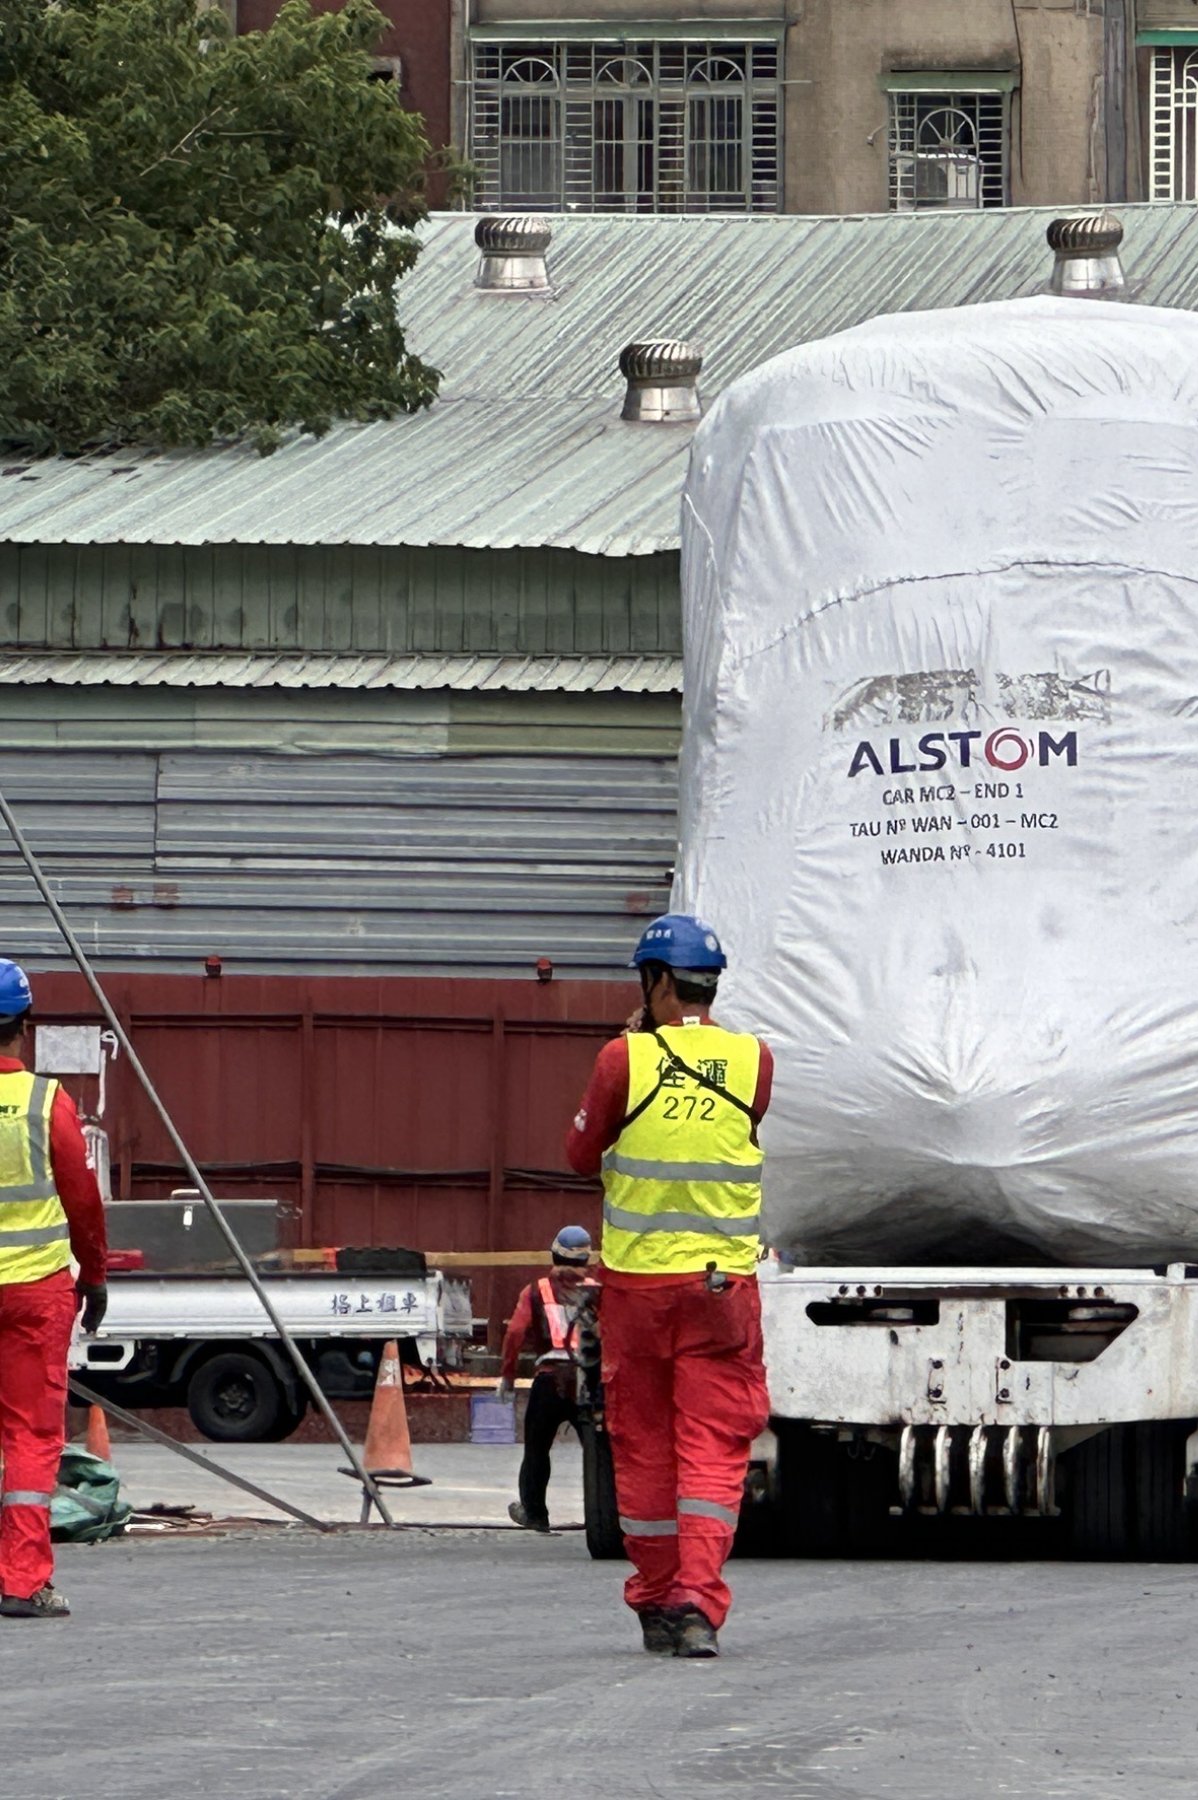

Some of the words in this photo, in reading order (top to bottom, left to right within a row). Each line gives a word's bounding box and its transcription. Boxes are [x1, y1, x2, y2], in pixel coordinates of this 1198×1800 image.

[847, 727, 1077, 777] ALSTOM
[882, 789, 915, 806] CAR
[920, 784, 956, 803] MC2
[974, 782, 1010, 799] END
[1015, 782, 1024, 799] 1
[849, 821, 881, 837] TAU
[911, 815, 952, 833] WAN
[970, 813, 1001, 829] 001
[1020, 813, 1059, 829] MC2
[881, 846, 946, 865] WANDA
[985, 842, 1026, 859] 4101
[662, 1095, 716, 1121] 272
